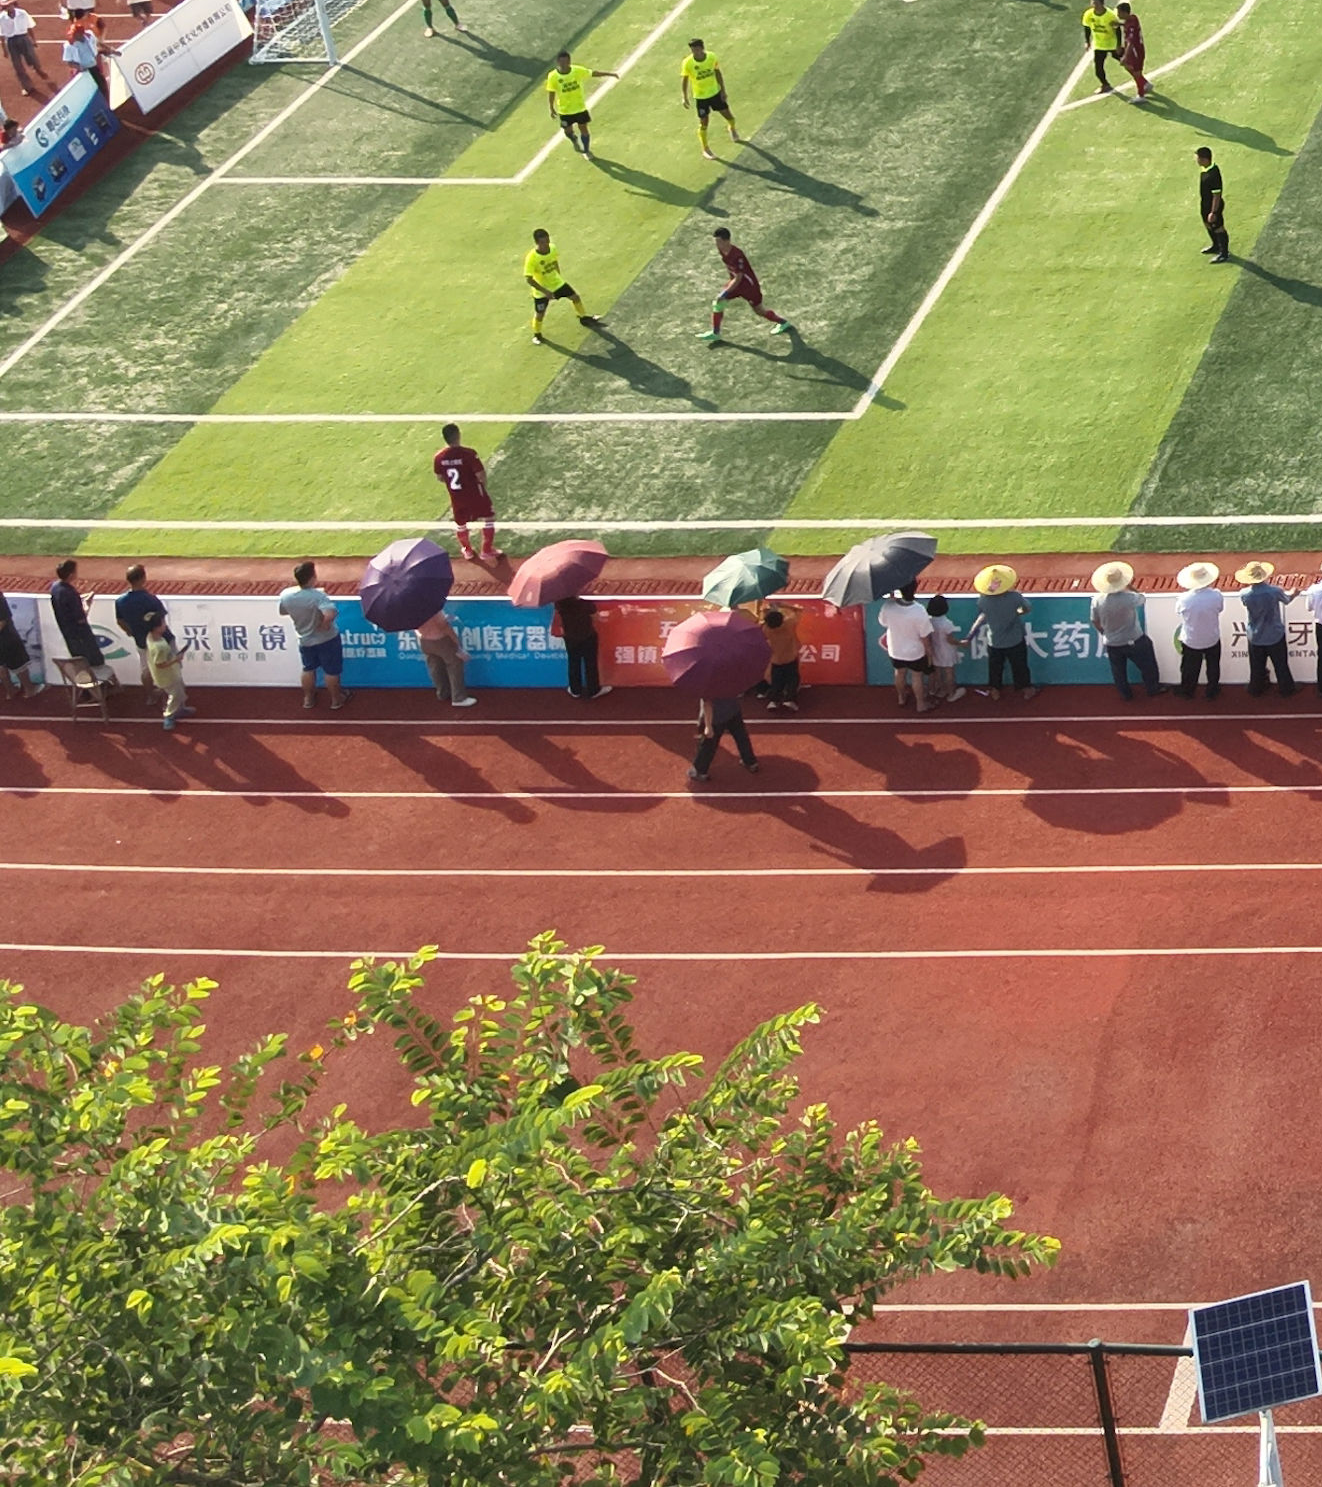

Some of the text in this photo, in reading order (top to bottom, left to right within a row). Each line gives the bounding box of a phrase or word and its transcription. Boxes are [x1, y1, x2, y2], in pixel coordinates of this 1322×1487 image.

[447, 467, 463, 491] 2
[182, 625, 287, 651] 采眼镜
